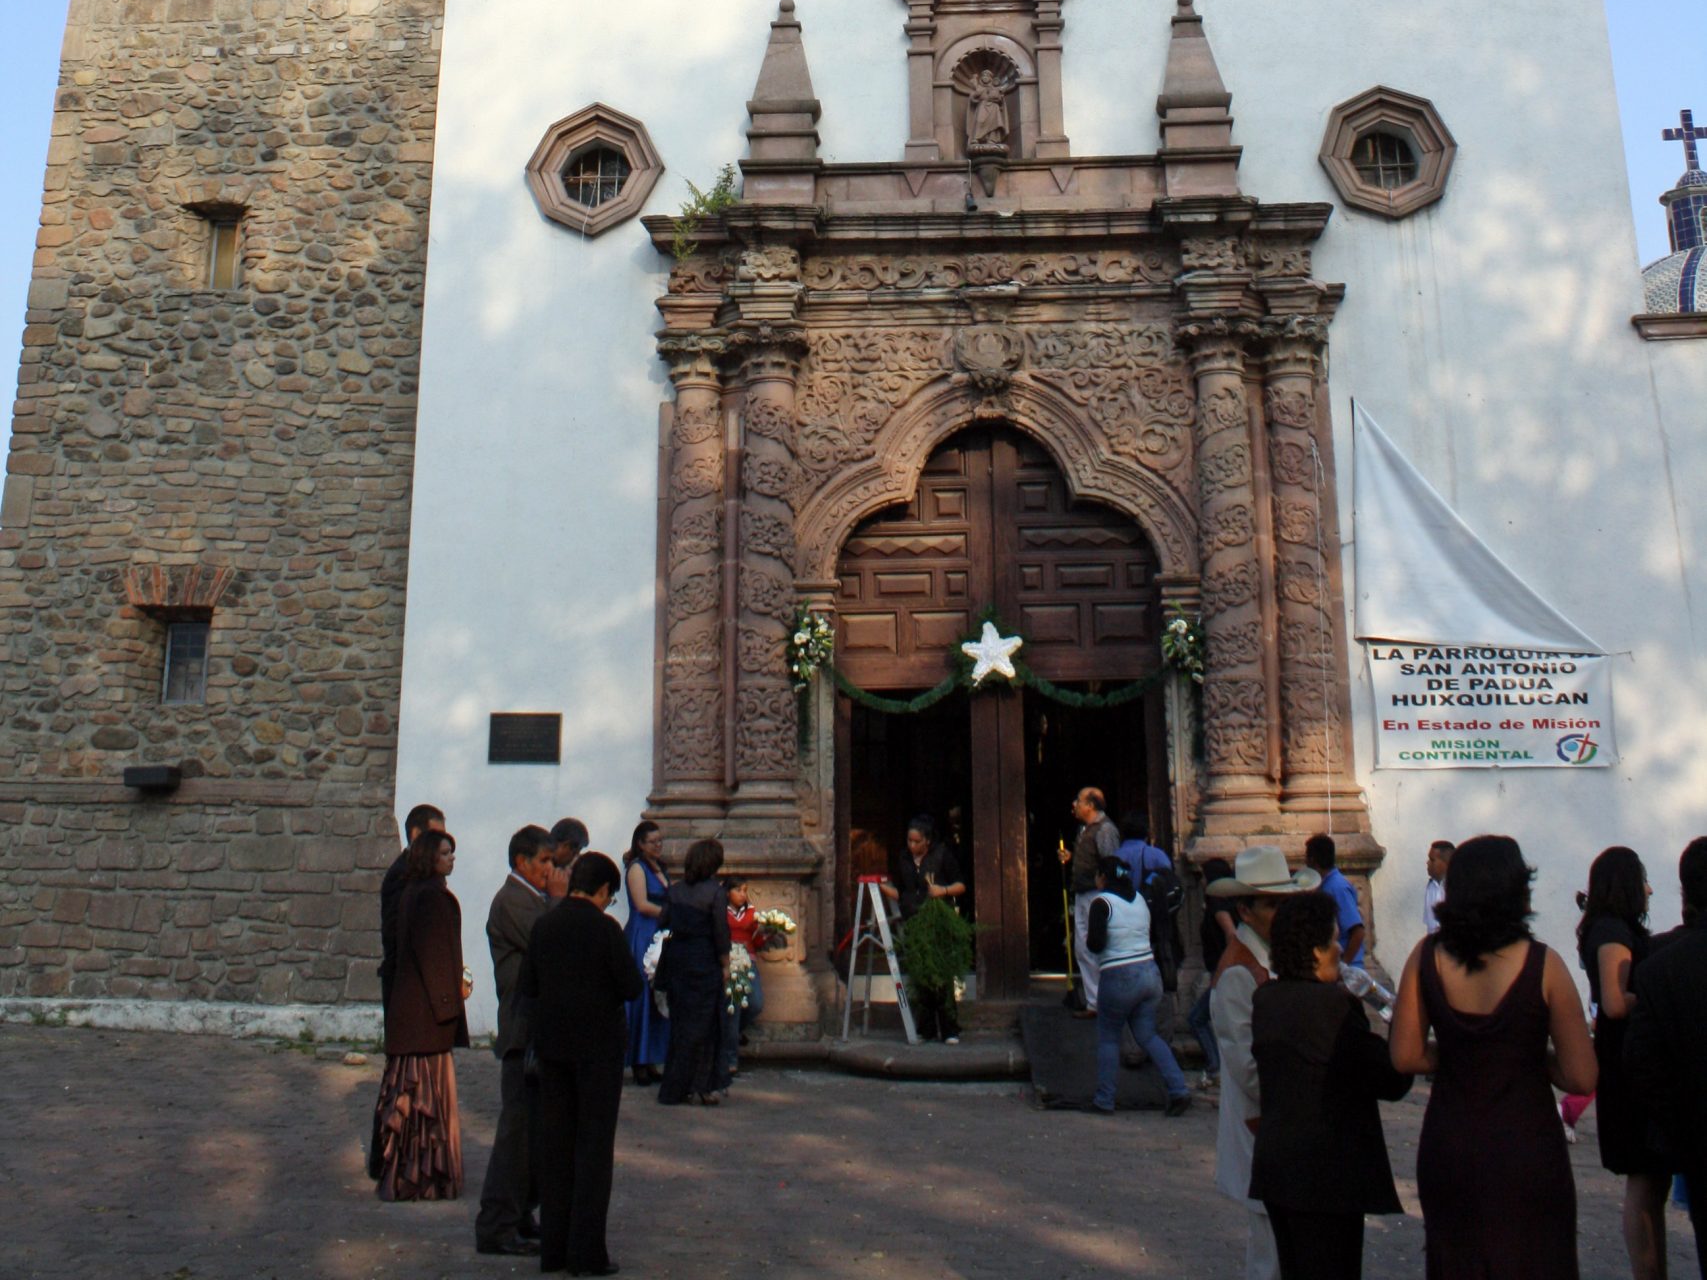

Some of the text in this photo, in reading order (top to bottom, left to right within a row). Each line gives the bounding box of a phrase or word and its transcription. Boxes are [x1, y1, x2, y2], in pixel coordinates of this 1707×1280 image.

[1373, 648, 1404, 661] LA
[1400, 662, 1577, 676] SAN ANTONIO
[1427, 678, 1553, 691] DE PADUA
[1392, 692, 1588, 707] HUIXQUILUCAN
[1383, 718, 1601, 731] En Estado de Misión
[1431, 738, 1500, 750] MISIÓN
[1399, 750, 1534, 761] CONTINENTAL
